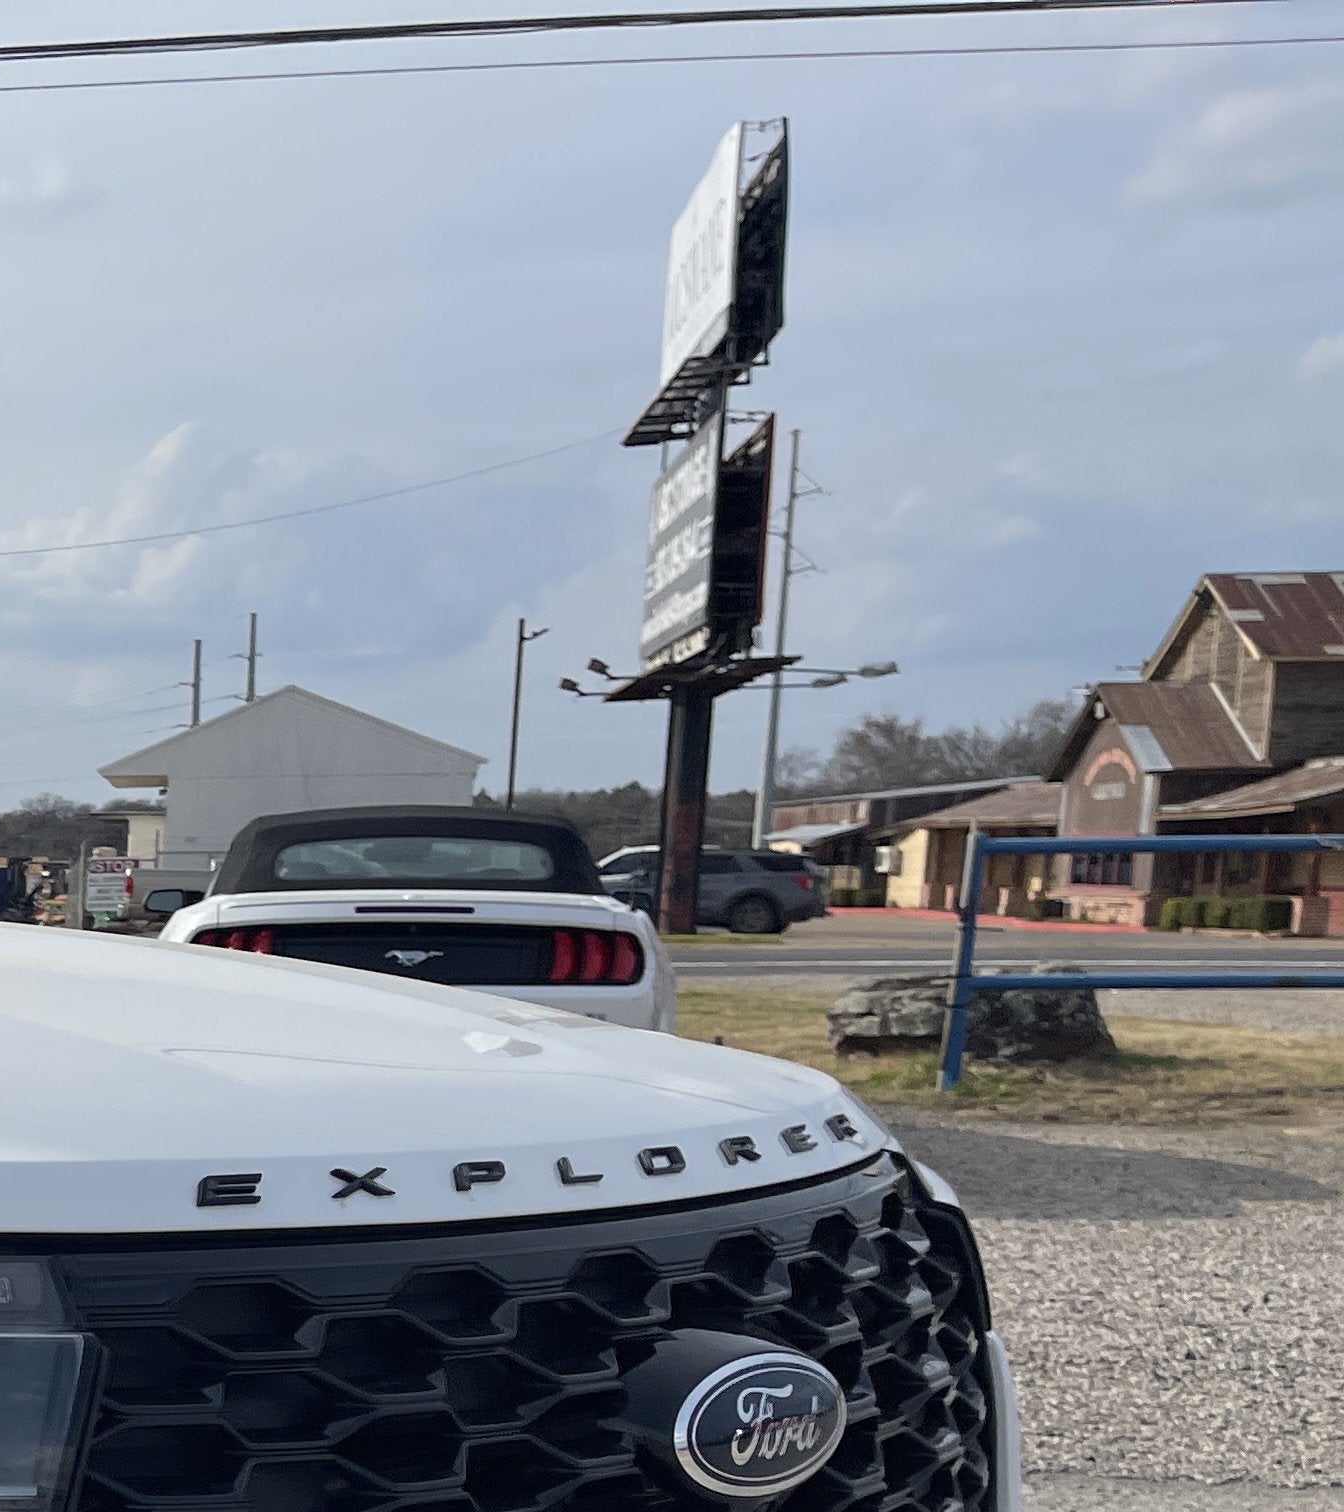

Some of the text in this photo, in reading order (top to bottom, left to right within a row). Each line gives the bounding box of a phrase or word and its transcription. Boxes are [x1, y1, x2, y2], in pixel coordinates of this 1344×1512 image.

[95, 860, 135, 873] STOP
[196, 1112, 866, 1208] EXPLORER
[731, 1383, 821, 1467] Ford
